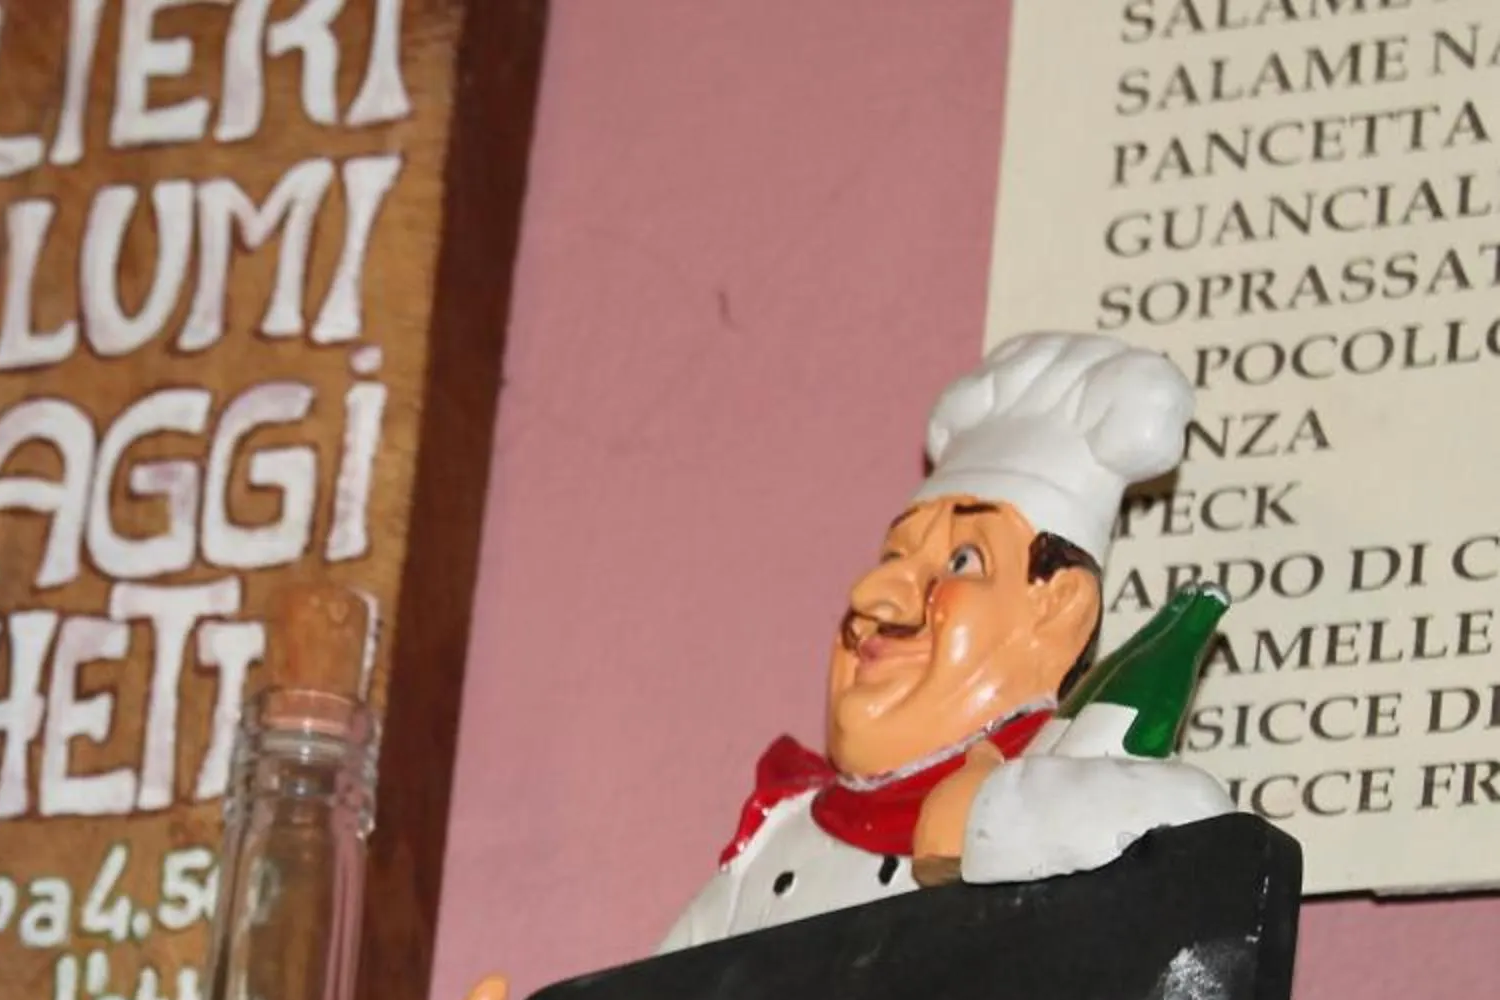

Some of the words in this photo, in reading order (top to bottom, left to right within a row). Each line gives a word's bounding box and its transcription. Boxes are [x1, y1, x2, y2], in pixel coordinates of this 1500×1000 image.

[1120, 0, 1412, 44] SALA
[1115, 35, 1409, 117] SALAME
[1110, 97, 1493, 188] PANCETTA
[1104, 172, 1500, 259] GUANCIAL
[1181, 408, 1333, 463] NZA
[1115, 480, 1301, 540] PECK
[1348, 542, 1431, 593] DI
[1199, 609, 1494, 679] AMELLE
[1186, 692, 1403, 753] SICCE
[1225, 767, 1396, 821] ICCE
